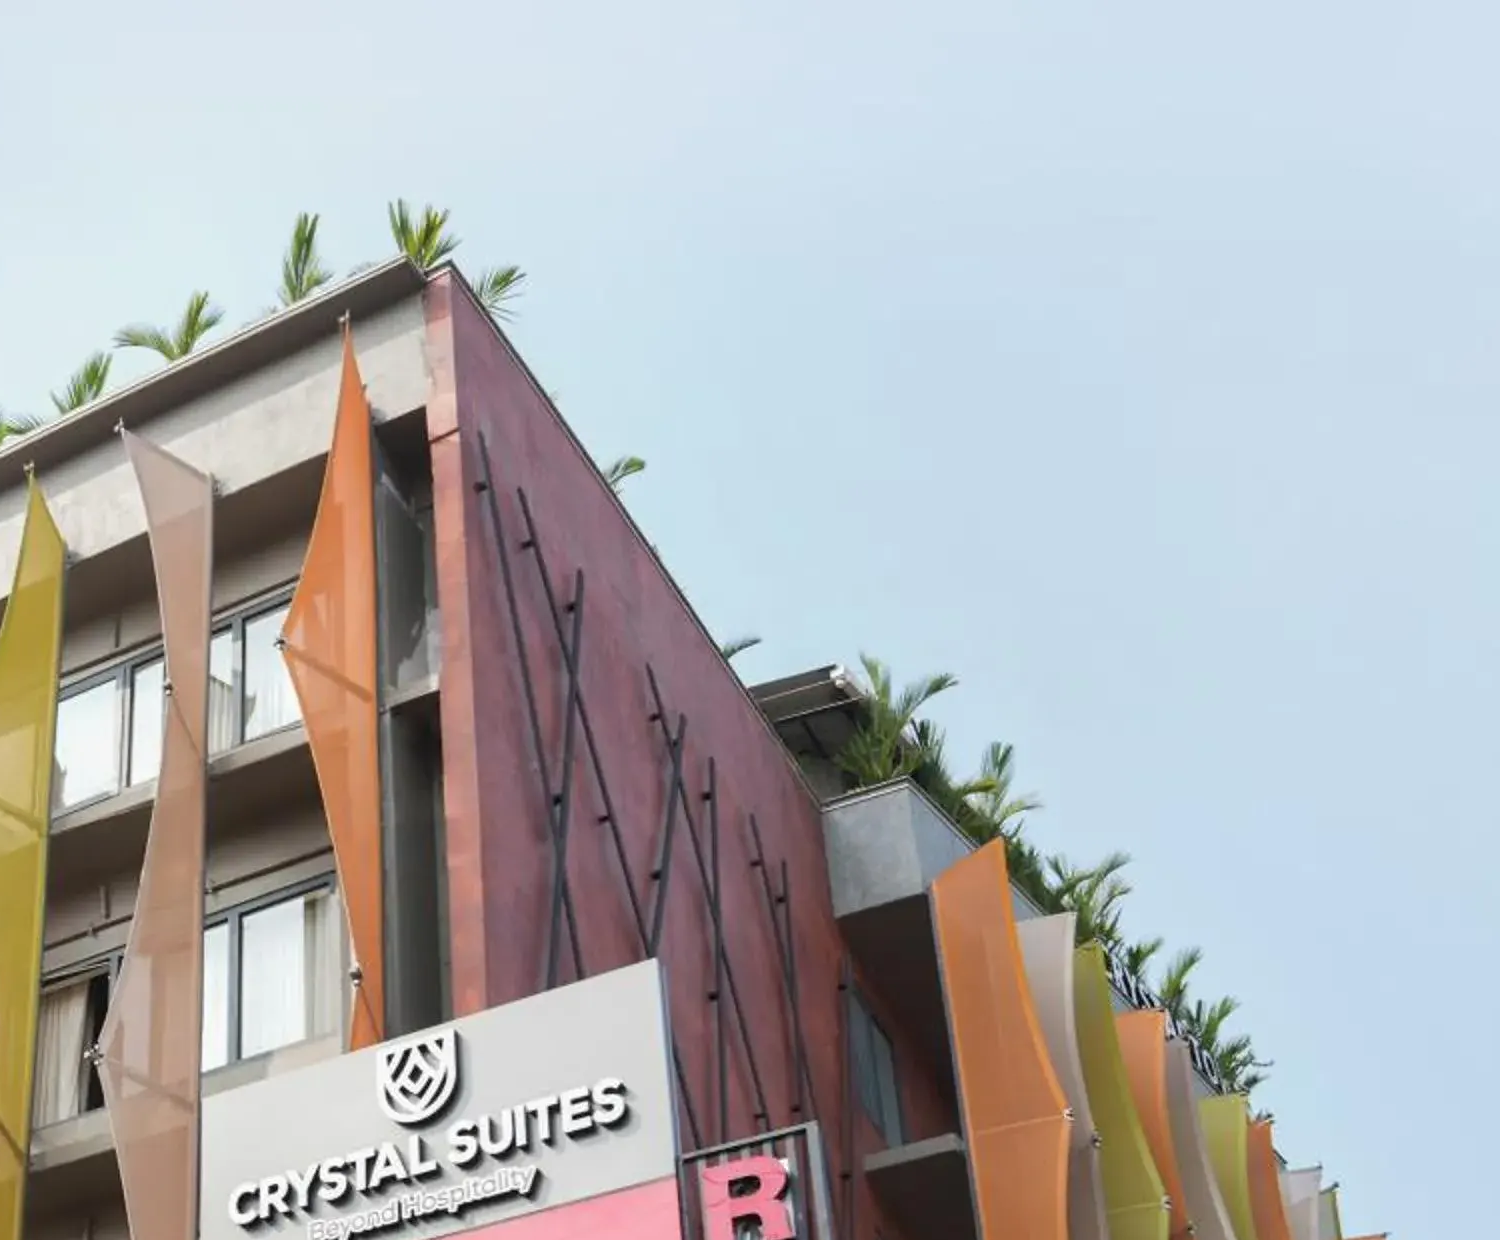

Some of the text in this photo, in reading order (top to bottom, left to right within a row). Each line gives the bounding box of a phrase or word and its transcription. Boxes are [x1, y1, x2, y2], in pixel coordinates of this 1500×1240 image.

[228, 1077, 627, 1226] CRYSTAL SUITES
[400, 1167, 538, 1218] Hospitality
